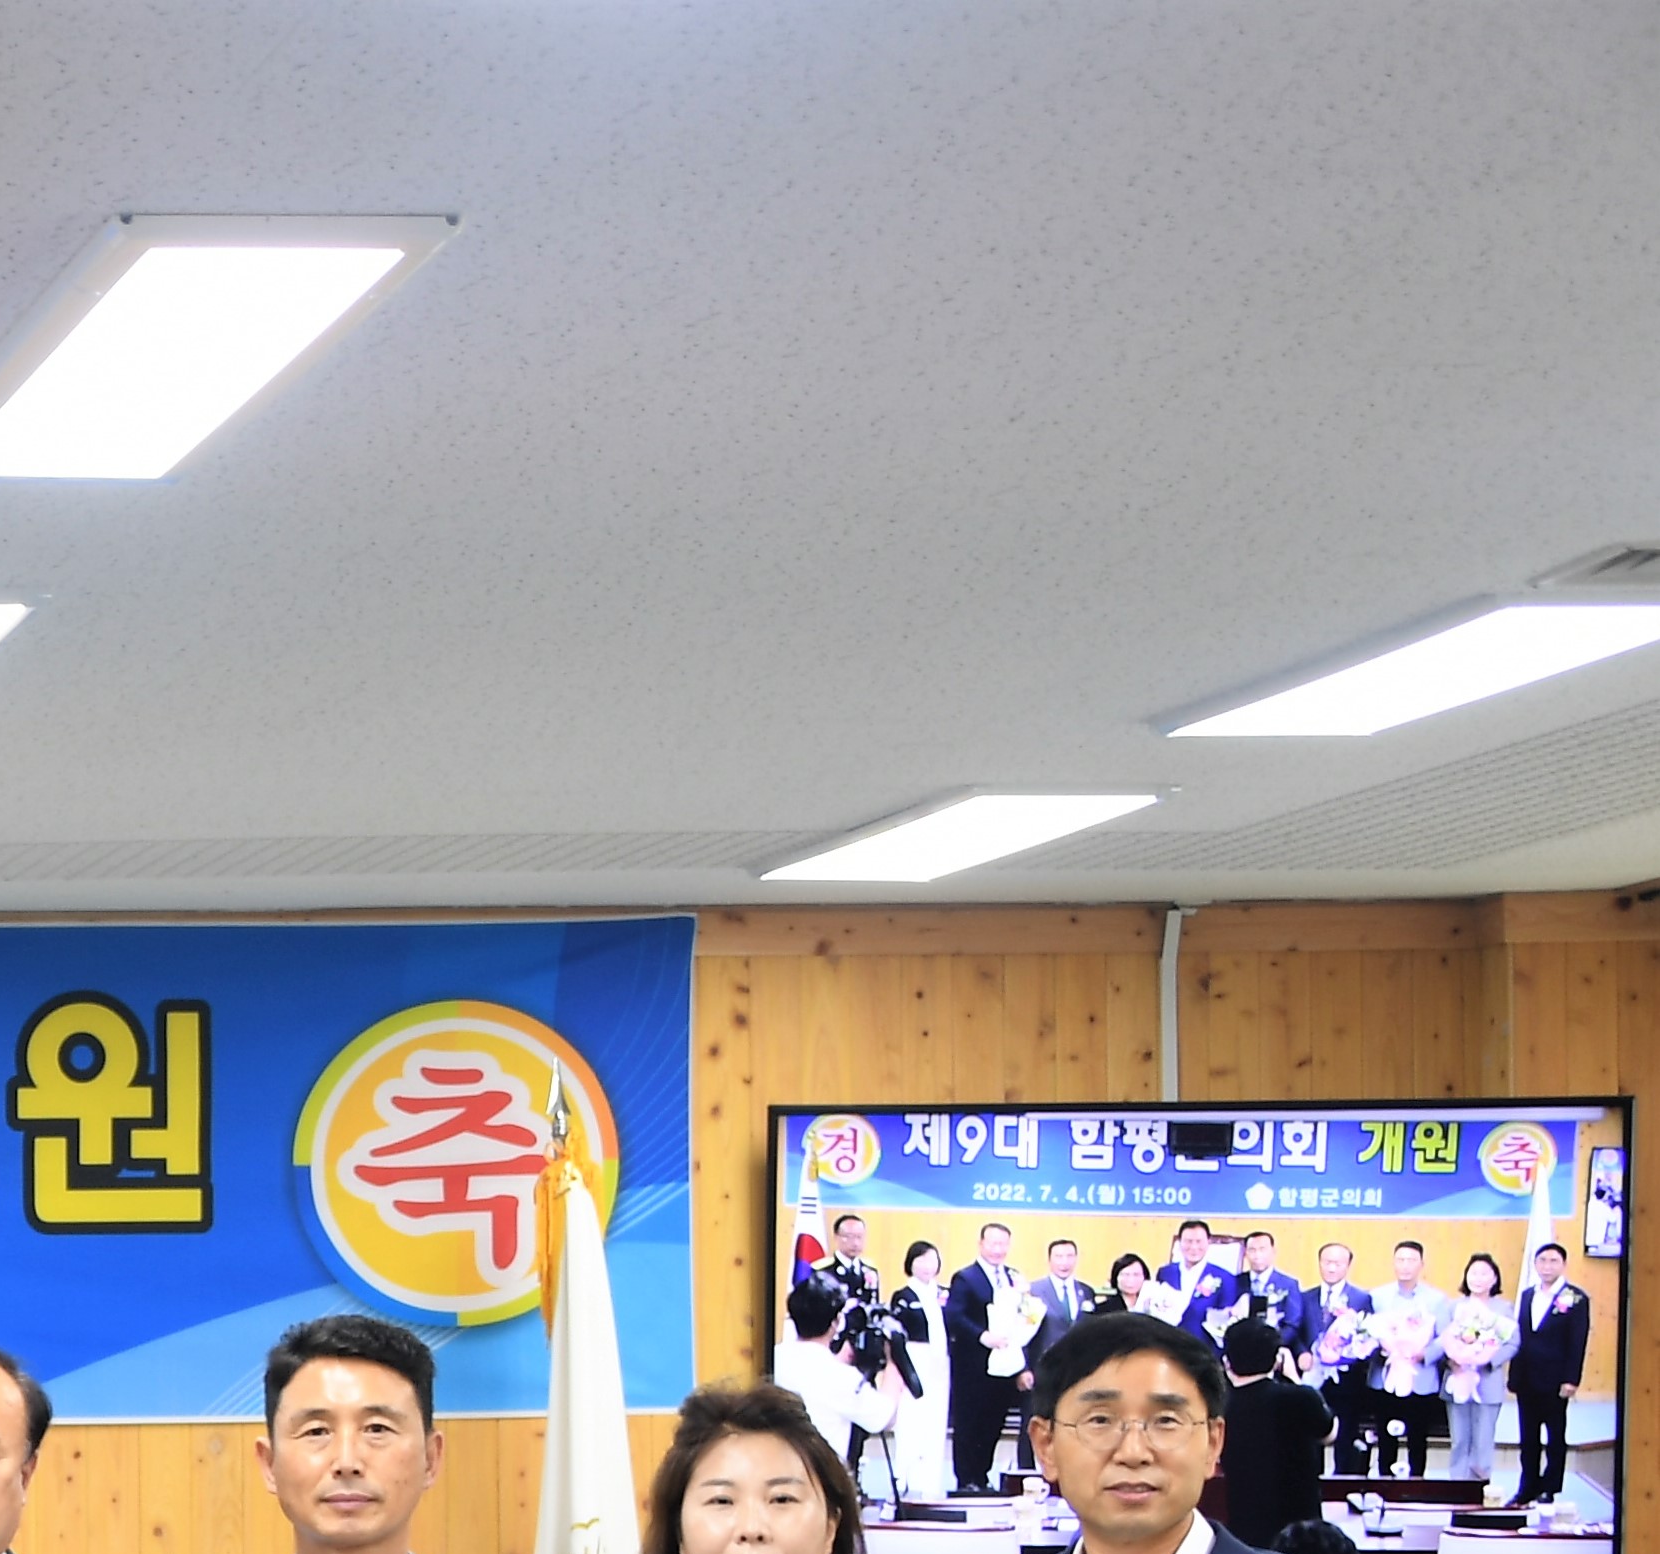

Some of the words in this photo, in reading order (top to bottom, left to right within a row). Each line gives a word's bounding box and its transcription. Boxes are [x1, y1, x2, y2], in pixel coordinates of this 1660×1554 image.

[353, 1063, 546, 1270] 축
[819, 1127, 858, 1174] 경
[903, 1113, 1040, 1169] 제9대
[1070, 1120, 1328, 1174] 함평의회
[1358, 1120, 1460, 1174] 개원
[1492, 1135, 1539, 1183] 축
[972, 1182, 1033, 1203] 2022.
[1039, 1184, 1058, 1203] 7.
[1132, 1186, 1192, 1206] 15:00
